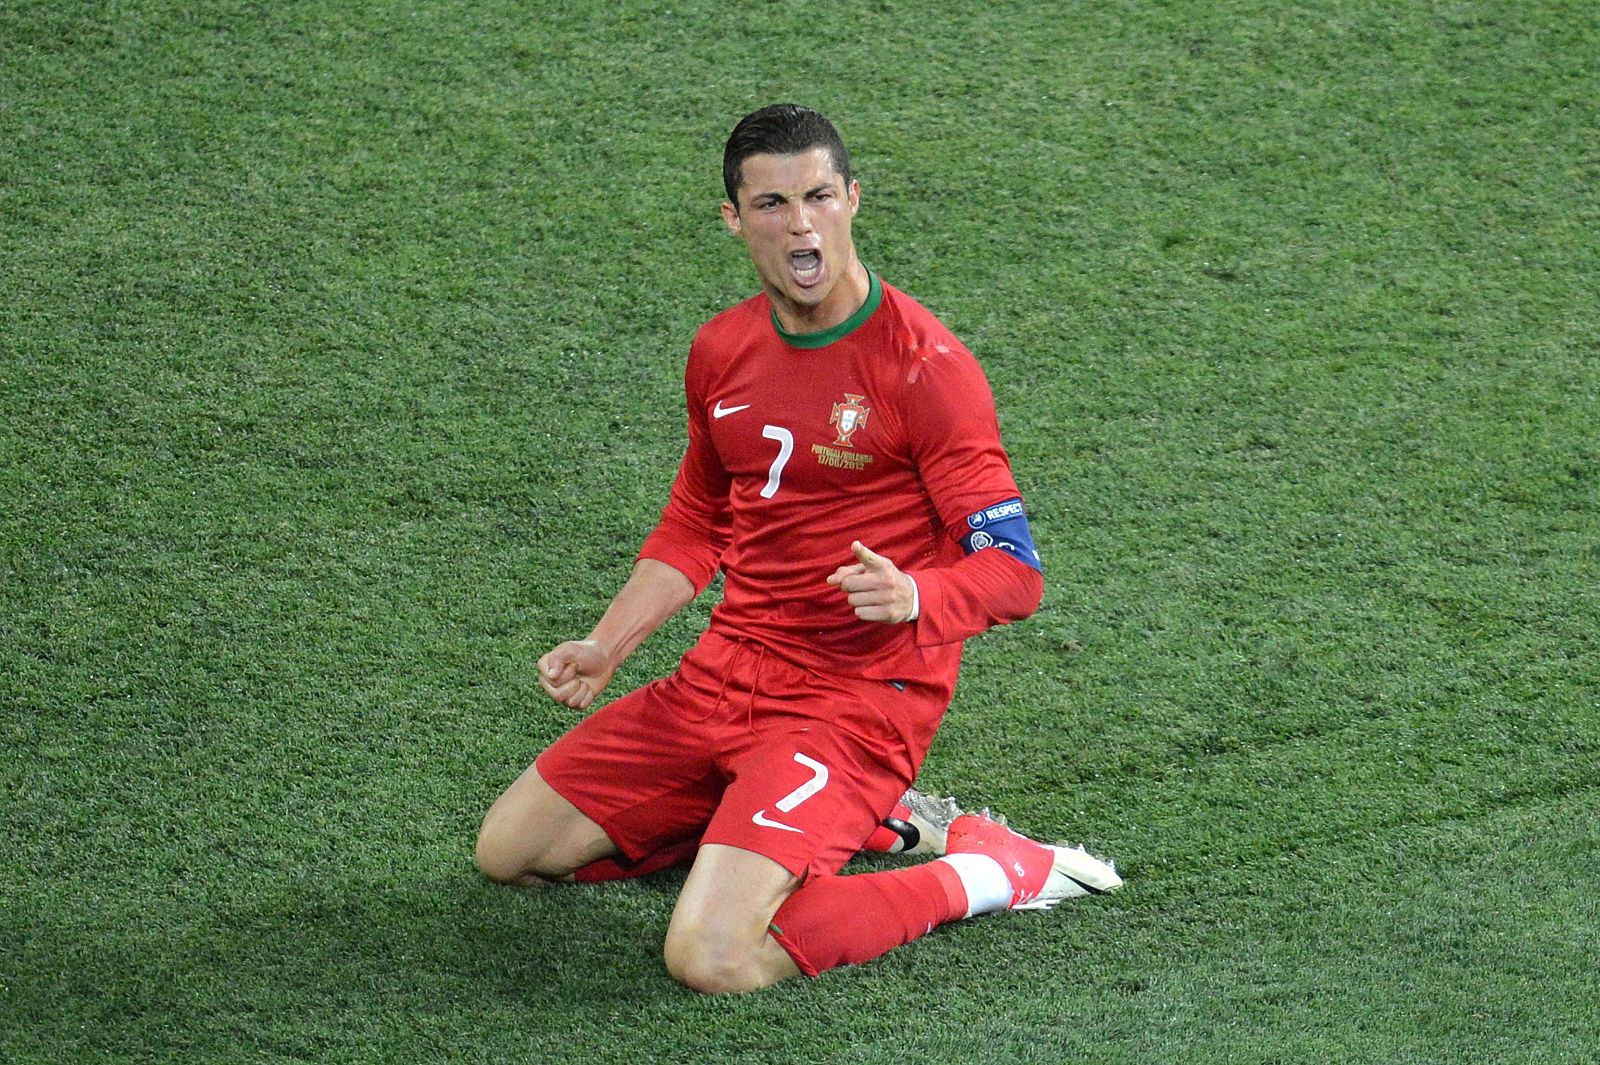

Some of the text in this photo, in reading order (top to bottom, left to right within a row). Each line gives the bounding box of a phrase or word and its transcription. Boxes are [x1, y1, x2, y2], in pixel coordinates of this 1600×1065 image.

[760, 424, 794, 499] 7
[818, 455, 864, 470] 17/06/2012
[985, 502, 1022, 520] RESPECT
[775, 752, 829, 813] 7
